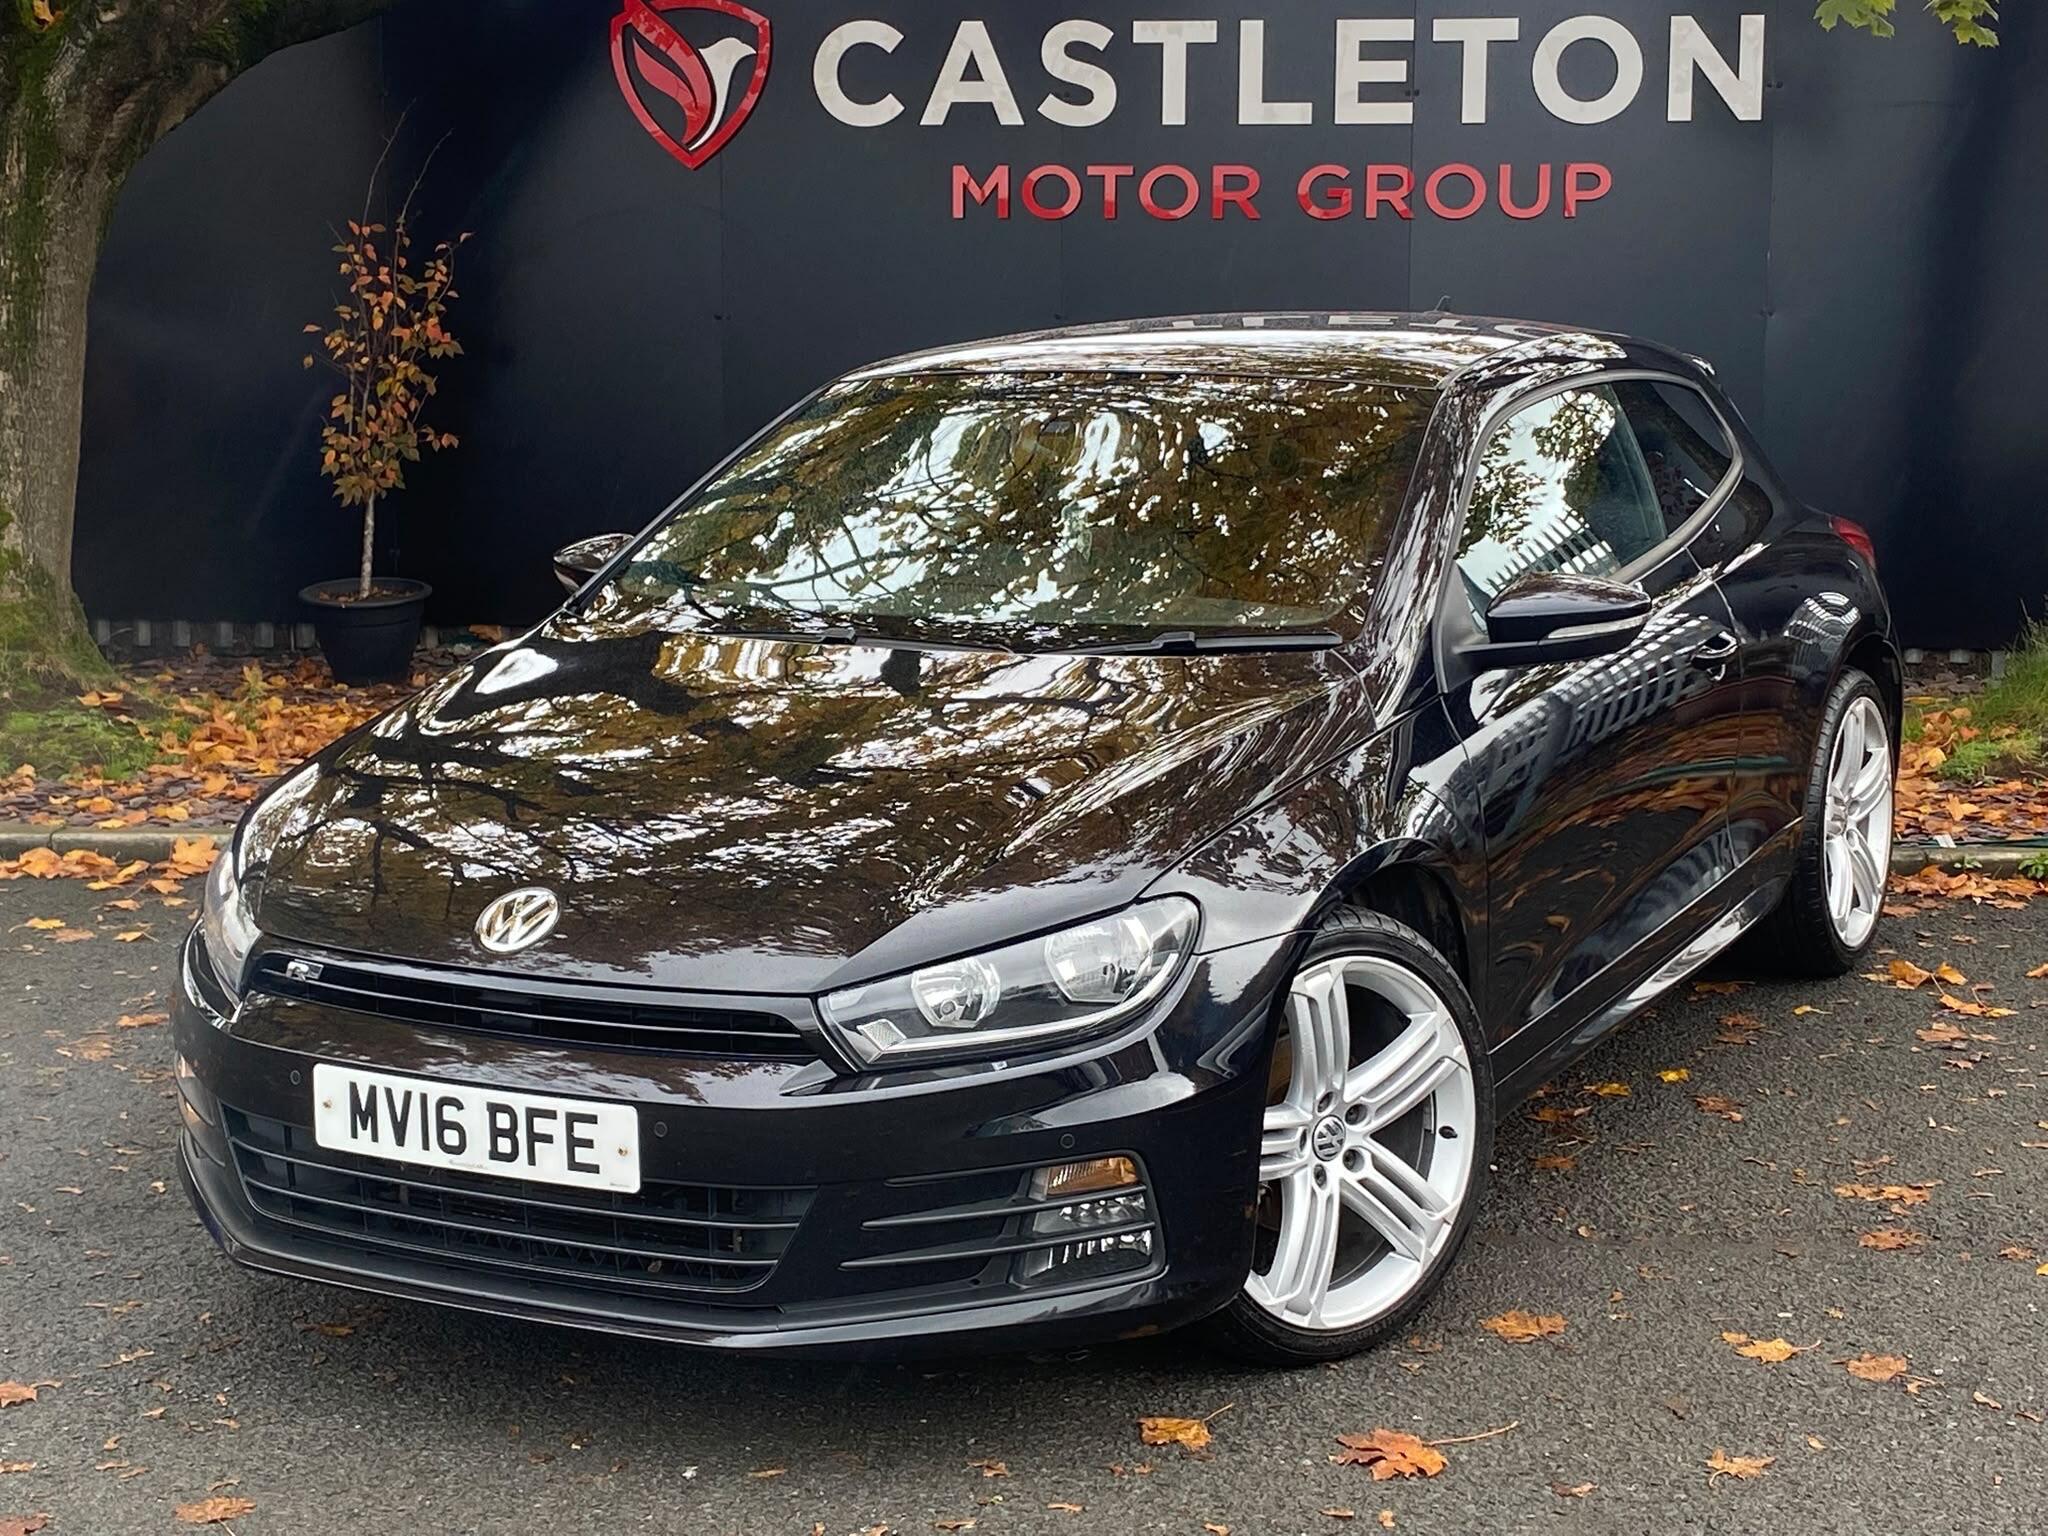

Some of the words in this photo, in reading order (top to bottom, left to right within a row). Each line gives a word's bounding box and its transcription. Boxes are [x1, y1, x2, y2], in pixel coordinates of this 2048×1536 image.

[812, 14, 1767, 128] CASTLETON
[952, 164, 1261, 221] MOTOR
[1296, 162, 1613, 220] GROUP
[349, 1081, 467, 1156] MV16
[486, 1102, 600, 1175] BFE
